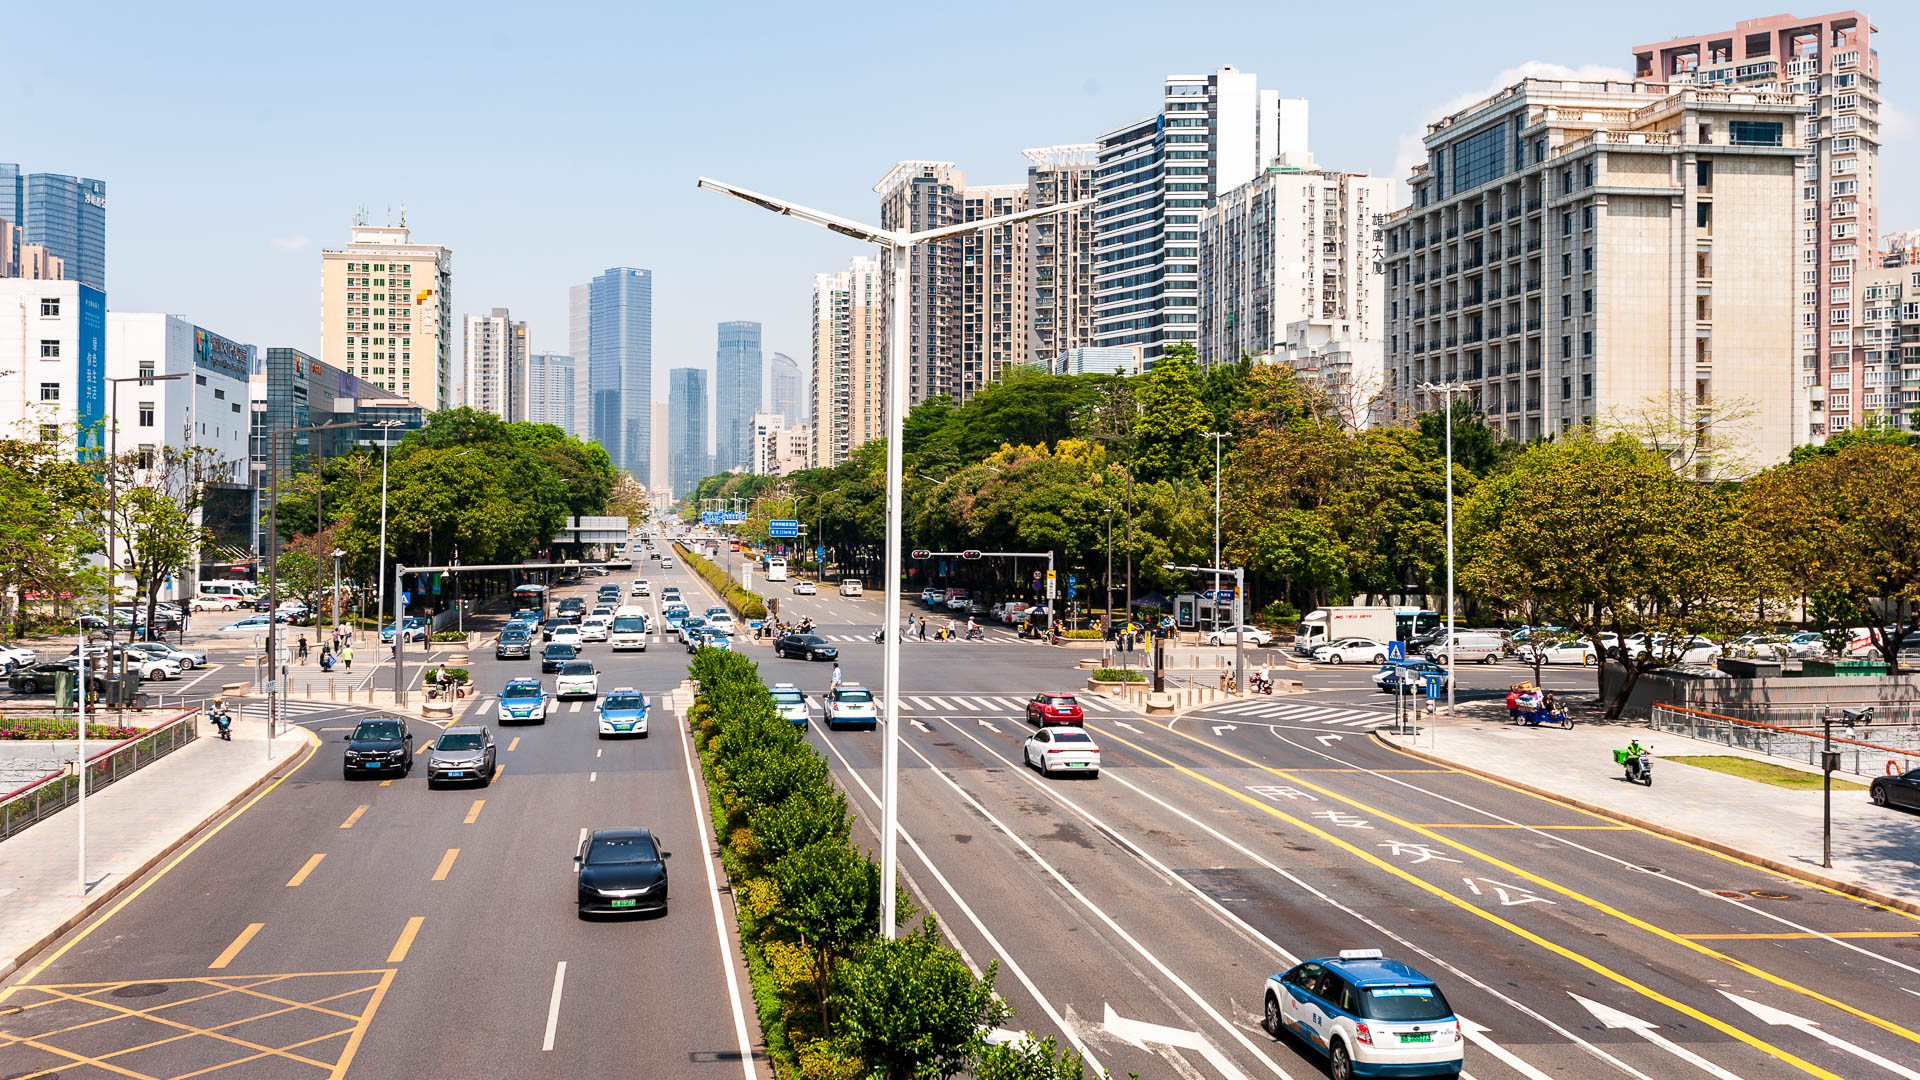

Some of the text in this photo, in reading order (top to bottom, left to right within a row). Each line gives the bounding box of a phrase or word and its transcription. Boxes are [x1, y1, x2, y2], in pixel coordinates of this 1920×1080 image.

[1372, 213, 1384, 275] 雄鹰大厦
[1245, 785, 1557, 906] 公交专用
